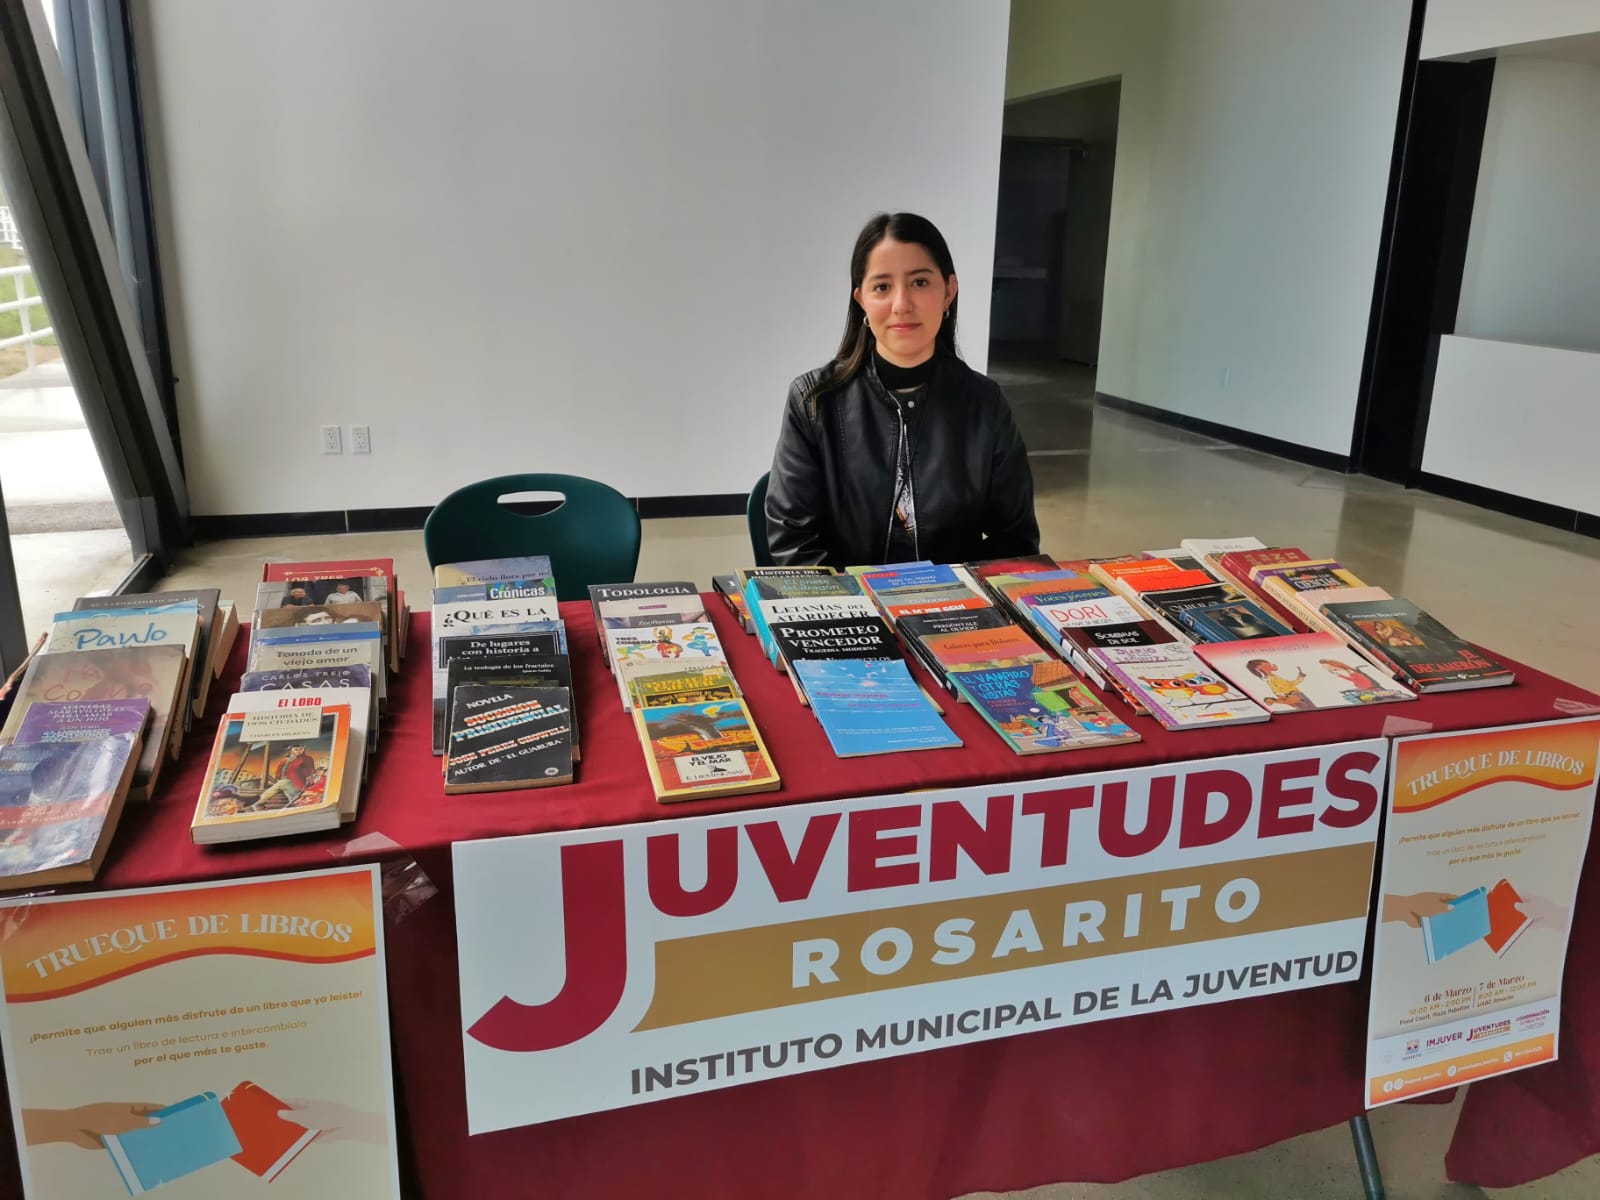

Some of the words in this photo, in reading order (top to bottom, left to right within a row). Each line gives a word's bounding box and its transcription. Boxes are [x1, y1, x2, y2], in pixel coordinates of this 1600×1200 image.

[490, 586, 546, 600] Crónicas
[597, 586, 692, 598] TODOLOGÍA
[501, 609, 520, 618] ES
[527, 607, 547, 616] LA
[770, 603, 842, 614] LETANÍAS
[777, 610, 870, 622] ATARDECER
[779, 624, 880, 638] PROMETEO
[470, 640, 487, 648] De
[489, 640, 531, 649] lugares
[788, 636, 884, 648] VENCEDOR
[276, 649, 322, 658] Tonada
[486, 646, 530, 654] historia
[283, 658, 314, 666] viejo
[316, 656, 350, 664] amor
[262, 672, 309, 681] CARLOS
[973, 670, 1030, 682] VAMPIRO
[292, 697, 322, 707] LOBO
[466, 693, 513, 709] NOVELA
[454, 762, 487, 776] AUTOR
[488, 758, 502, 766] DE
[1407, 752, 1494, 797] TRUEQUE
[1498, 750, 1521, 766] DE
[1526, 750, 1585, 776] LIBROS
[466, 752, 1382, 1052] JUVENTUDES
[792, 877, 1261, 988] ROSARITO
[26, 918, 178, 980] TRUEQUE
[188, 914, 229, 936] DE
[239, 913, 353, 944] LIBROS
[29, 1027, 82, 1044] ¡Permite
[83, 1022, 107, 1037] que
[108, 1017, 153, 1034] alguien
[154, 1012, 180, 1026] más
[182, 1006, 228, 1022] disfrute
[229, 1004, 244, 1016] de
[246, 1003, 261, 1013] un
[262, 999, 288, 1011] libro
[290, 998, 312, 1010] que
[312, 994, 328, 1006] ya
[630, 1031, 843, 1096] INSTITUTO
[854, 996, 1063, 1056] MUNICIPAL
[1072, 985, 1121, 1015] DE
[1130, 978, 1174, 1006] LA
[1182, 950, 1358, 998] JUVENTUD
[1466, 1018, 1512, 1042] JUVENTUDES
[86, 1045, 114, 1058] Trae
[116, 1043, 132, 1054] un
[133, 1038, 158, 1050] libro
[160, 1036, 176, 1047] de
[178, 1031, 220, 1045] lectura
[221, 1031, 230, 1039] e
[1426, 1032, 1463, 1048] IMJUVER
[133, 1055, 154, 1068] por
[156, 1052, 168, 1064] el
[168, 1050, 192, 1064] que
[193, 1046, 218, 1058] más
[220, 1044, 232, 1054] te
